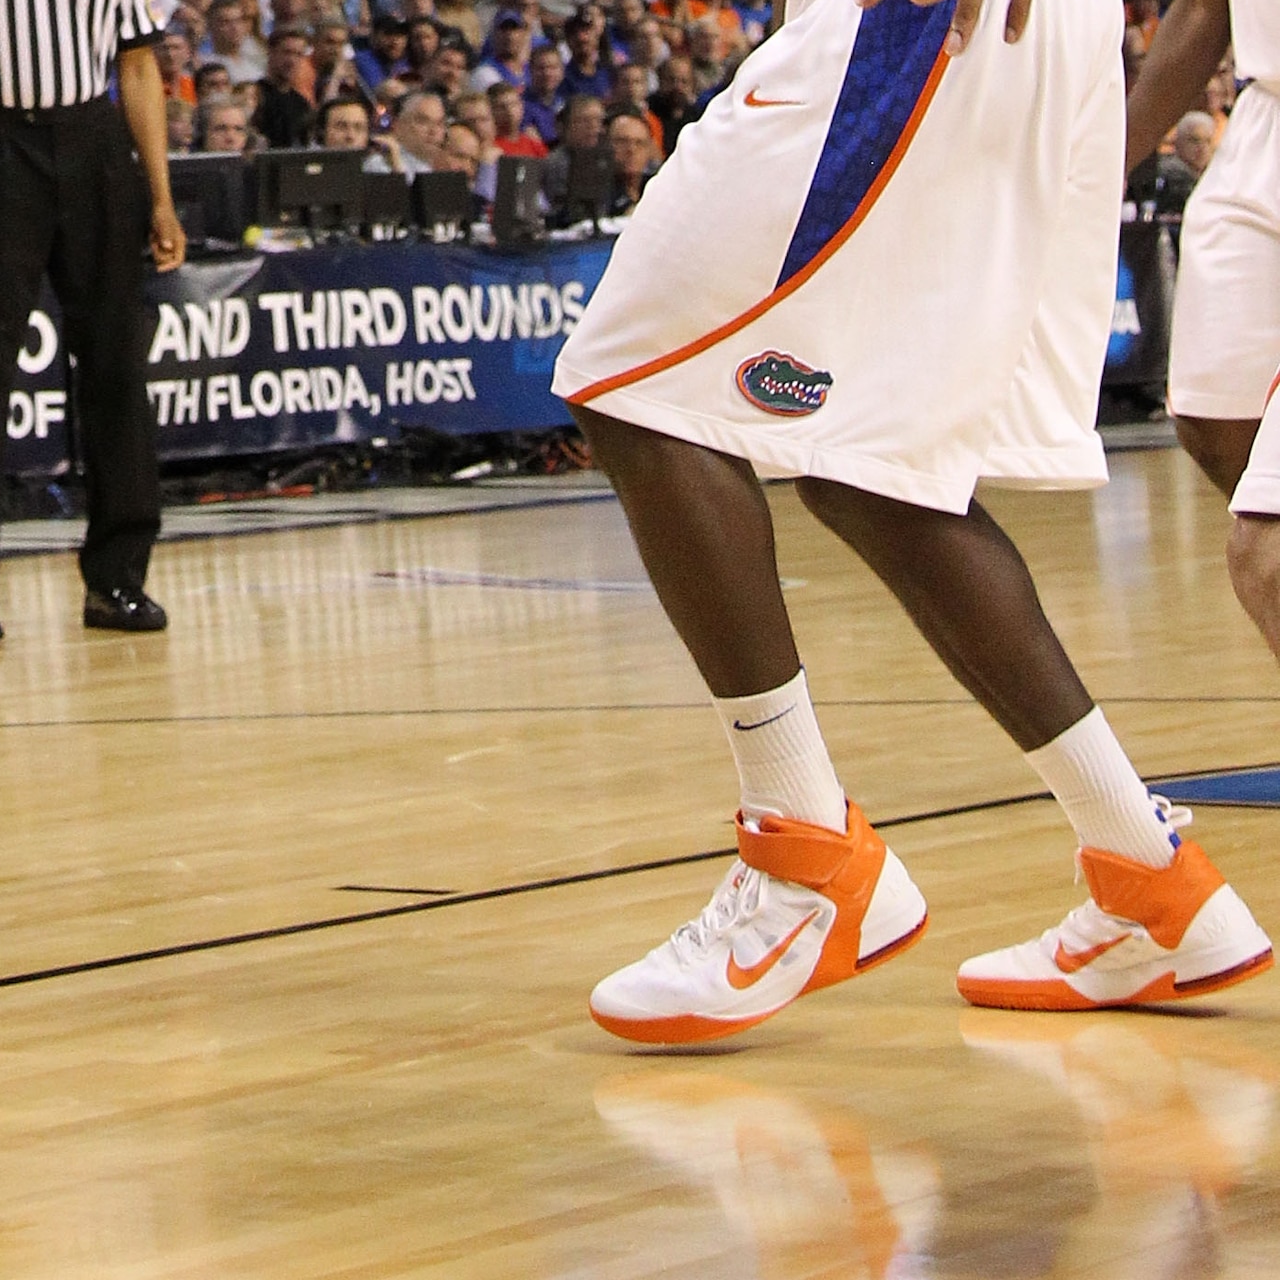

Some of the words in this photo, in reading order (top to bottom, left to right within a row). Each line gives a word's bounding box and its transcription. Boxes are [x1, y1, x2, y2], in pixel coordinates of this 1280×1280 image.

[148, 296, 251, 364] AND
[258, 286, 408, 353] THIRD
[412, 280, 586, 345] ROUNDS
[6, 390, 68, 440] OF
[207, 365, 382, 421] FLORIDA,
[386, 357, 477, 407] HOST
